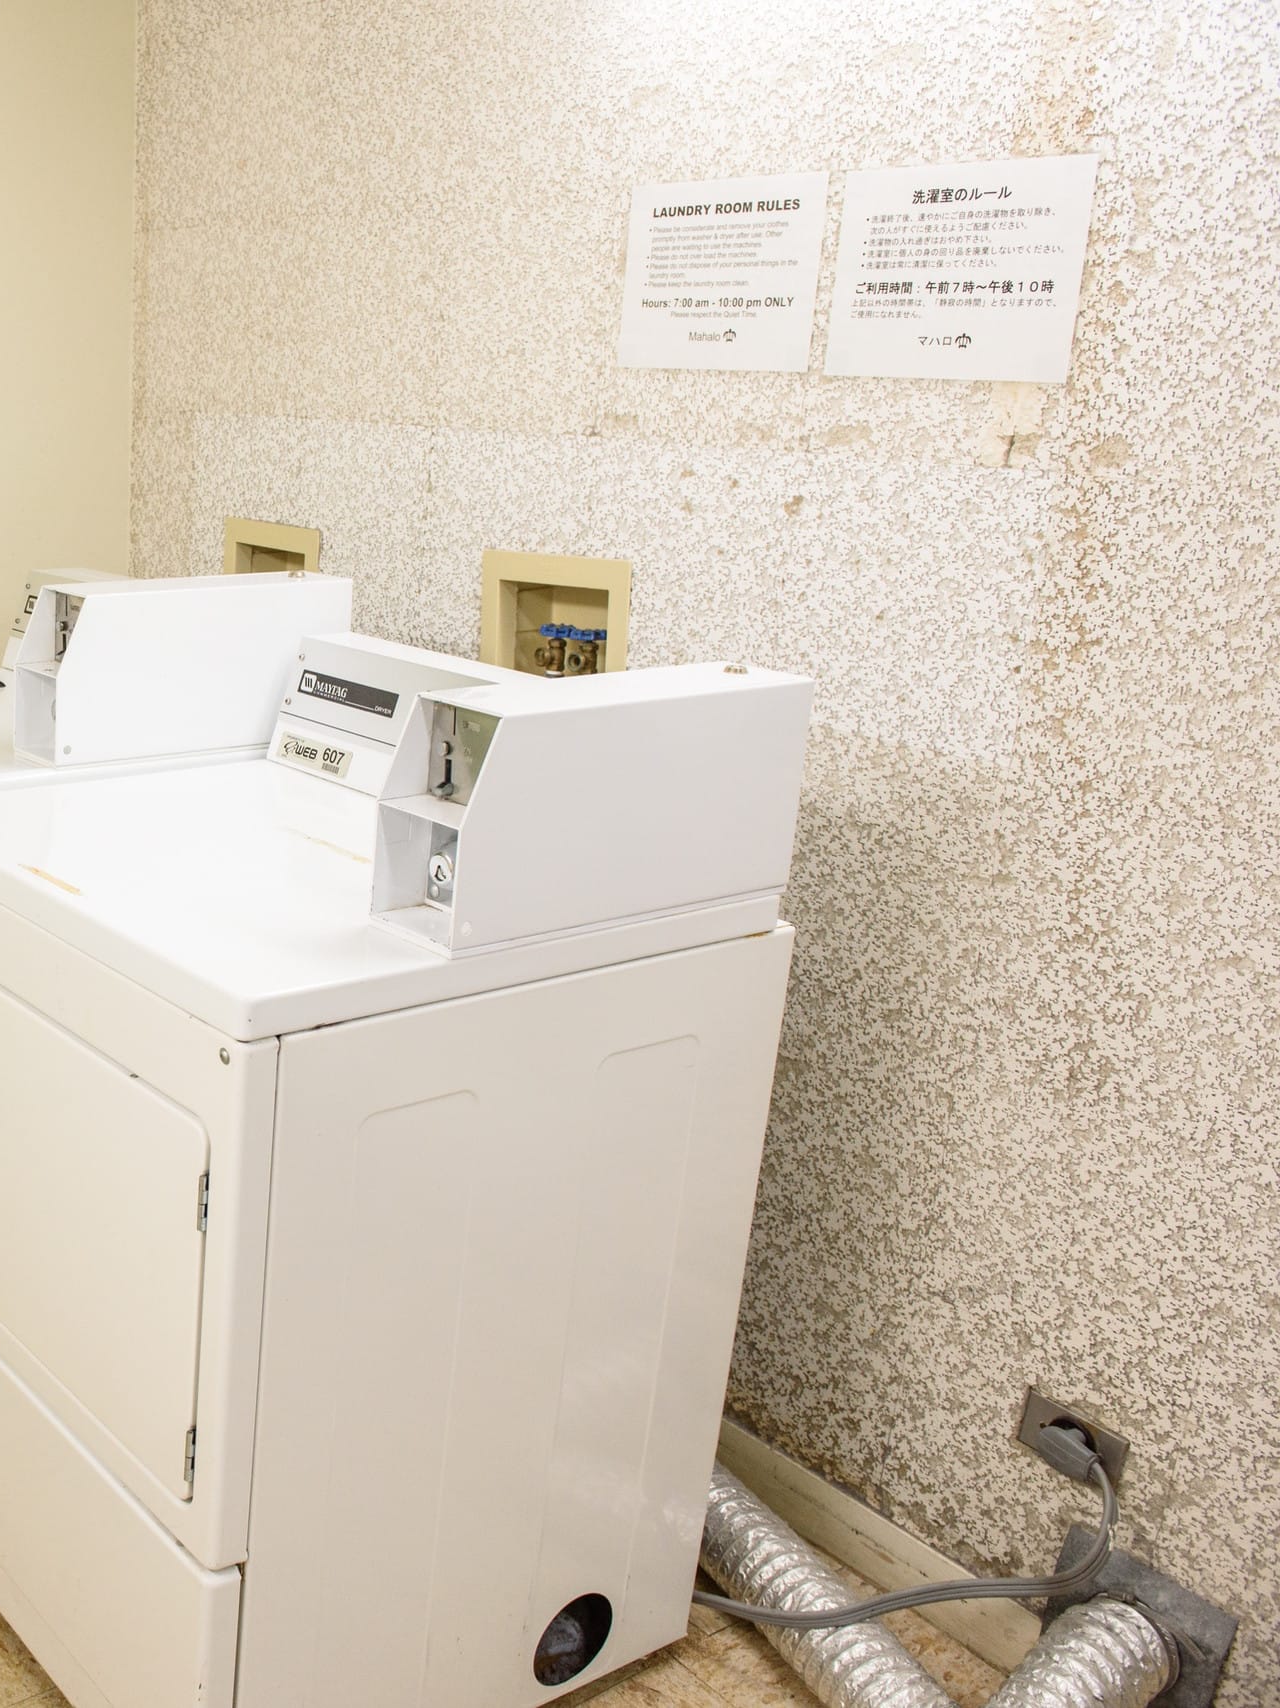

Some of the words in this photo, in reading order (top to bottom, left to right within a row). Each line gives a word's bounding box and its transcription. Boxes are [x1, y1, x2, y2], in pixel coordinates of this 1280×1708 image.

[912, 186, 1012, 204] 洗濯室のルール
[653, 204, 711, 218] LAUNDRY
[715, 202, 753, 214] ROOM
[757, 199, 800, 212] RULES
[642, 298, 671, 308] Hours:
[674, 298, 692, 308] 7:00
[695, 299, 709, 307] am
[718, 298, 743, 307] 10:00
[746, 298, 761, 309] pm
[764, 297, 794, 307] ONLY
[691, 311, 711, 319] respect
[688, 332, 721, 342] Mahalo
[918, 336, 952, 346] マハロ
[315, 681, 348, 698] MAYTAG
[374, 706, 392, 715] DRYER
[295, 744, 318, 760] WEB
[323, 748, 345, 765] 607
